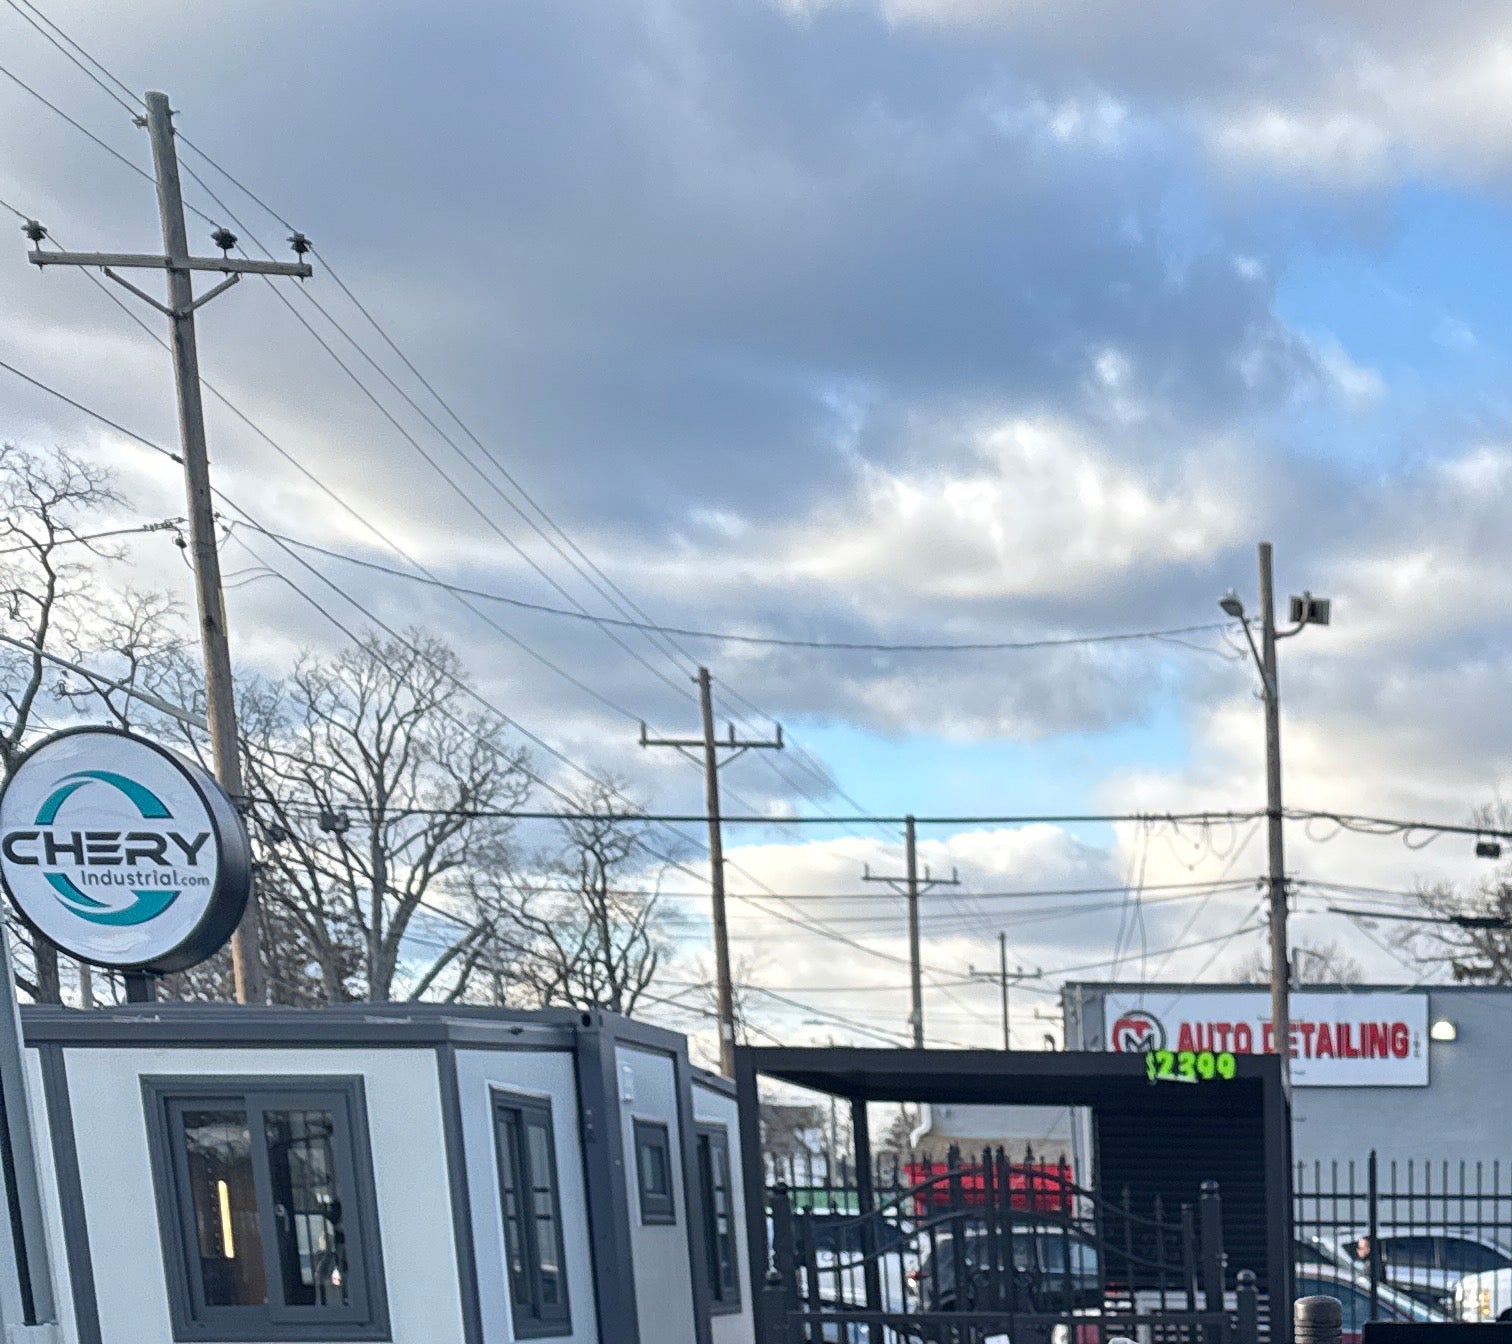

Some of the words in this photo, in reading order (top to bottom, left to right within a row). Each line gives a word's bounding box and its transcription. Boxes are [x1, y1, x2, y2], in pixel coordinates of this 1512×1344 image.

[2, 831, 211, 866] CHERY
[81, 870, 210, 887] Industrial.com
[1177, 1022, 1253, 1054] AUTO
